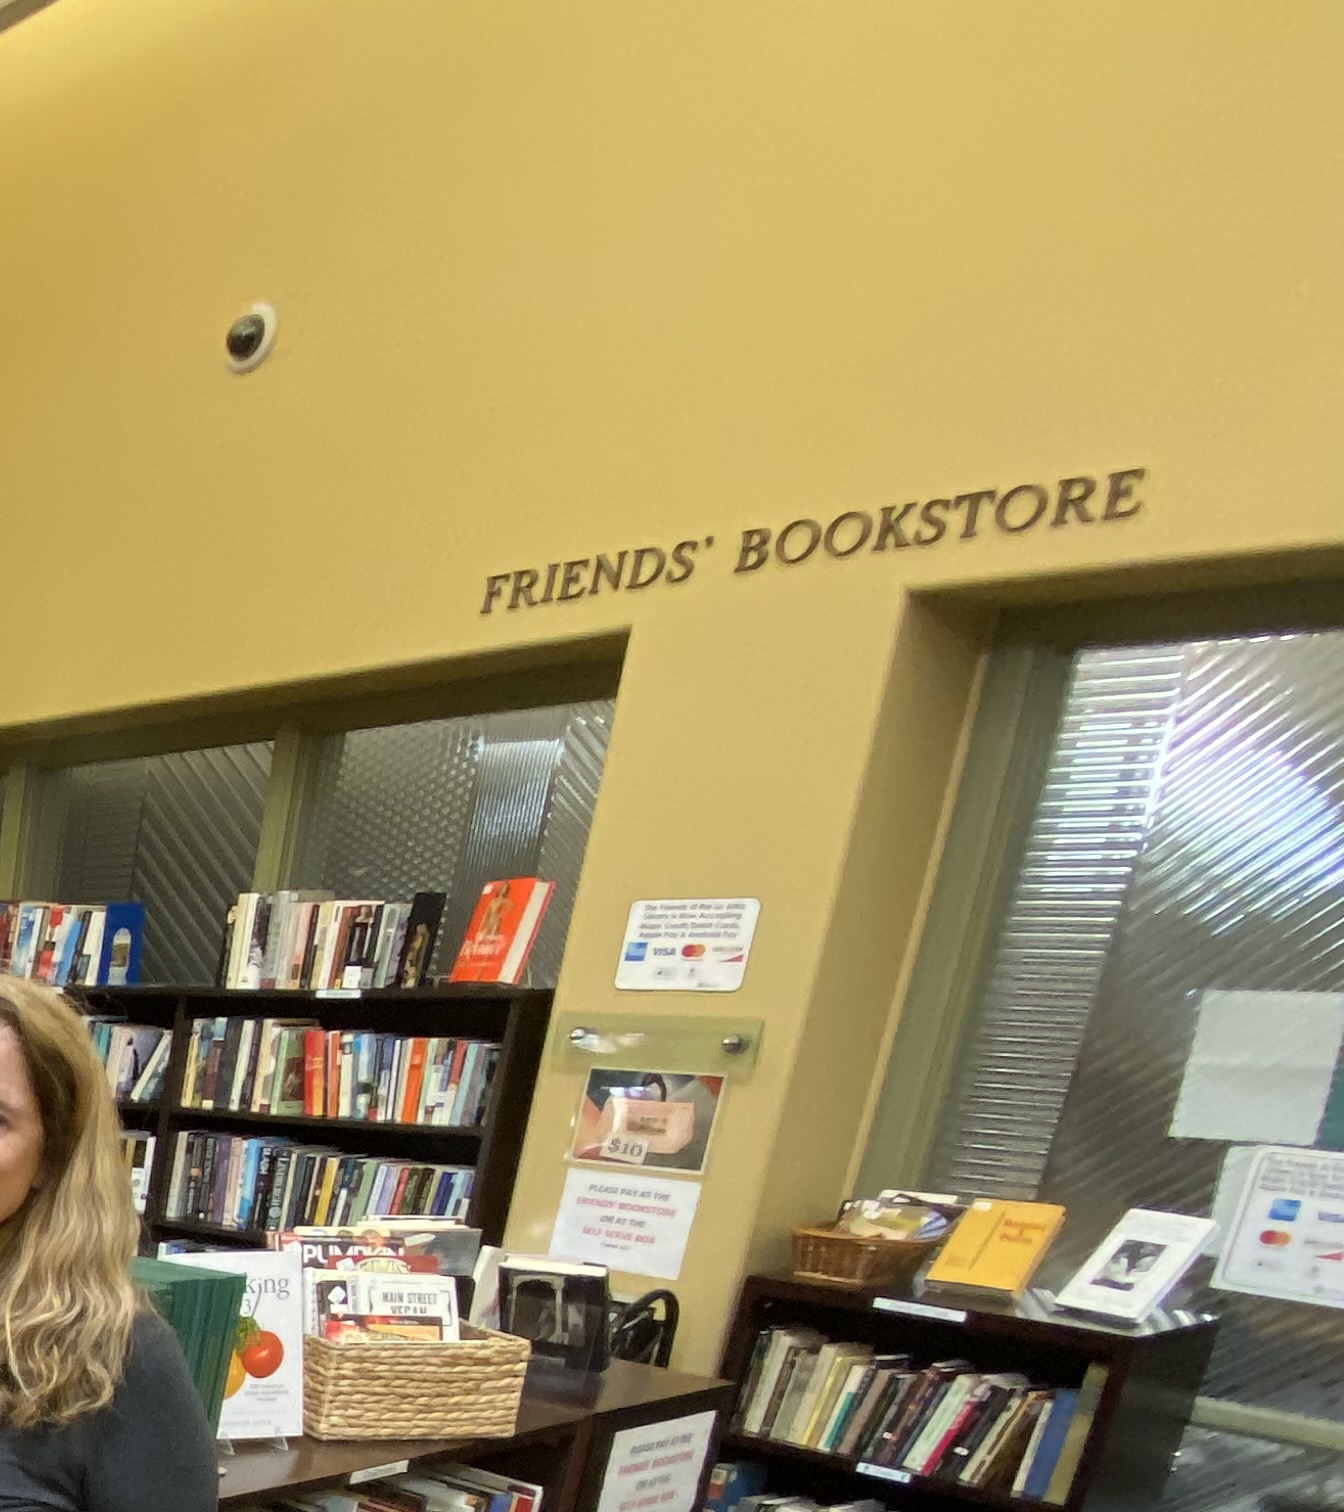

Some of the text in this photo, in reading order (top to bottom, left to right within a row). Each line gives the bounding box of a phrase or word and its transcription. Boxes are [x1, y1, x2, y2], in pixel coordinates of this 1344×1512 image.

[480, 467, 1146, 615] FRIENDS' BOOKSTORE
[653, 947, 676, 956] VISA
[608, 1136, 643, 1158] $10
[588, 1183, 671, 1201] PLEASE PAY AT THE
[618, 1202, 678, 1218] BOOKSTORE
[600, 1214, 646, 1228] OR AT THE
[244, 1277, 290, 1300] king
[382, 1291, 438, 1306] MAIN STREET
